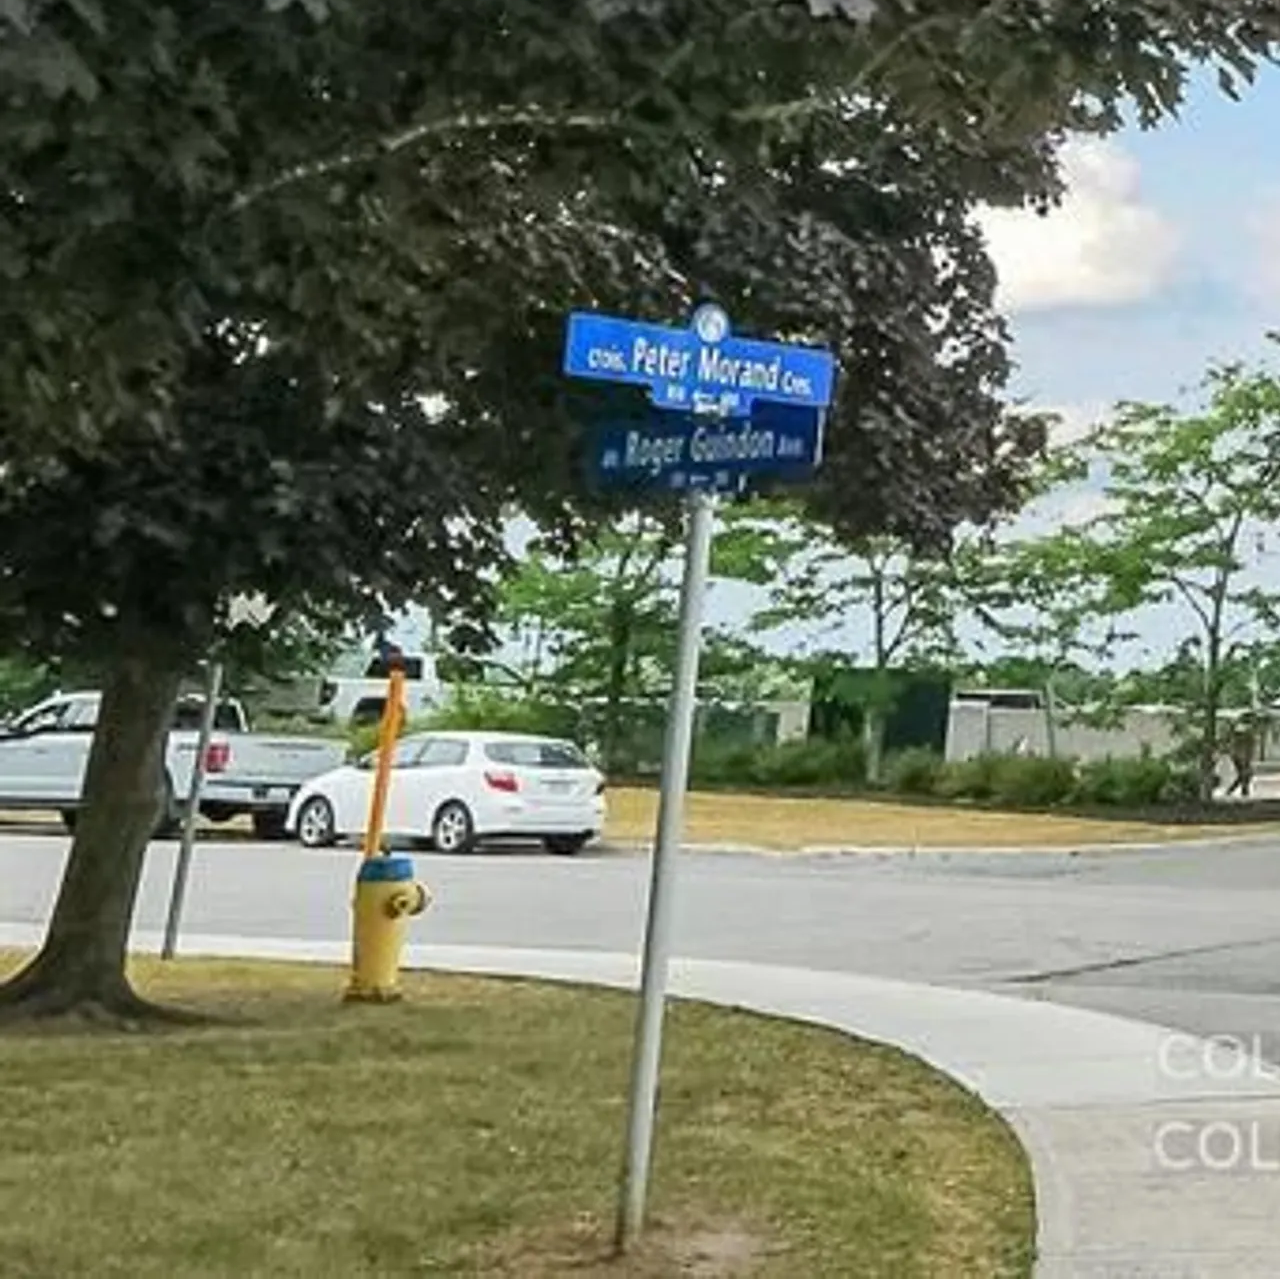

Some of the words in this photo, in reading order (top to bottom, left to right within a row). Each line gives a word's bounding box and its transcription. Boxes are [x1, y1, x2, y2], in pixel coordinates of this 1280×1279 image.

[633, 337, 692, 379] Peter
[698, 345, 781, 391] Morand
[625, 431, 685, 476] Roger
[690, 422, 775, 462] Guindon
